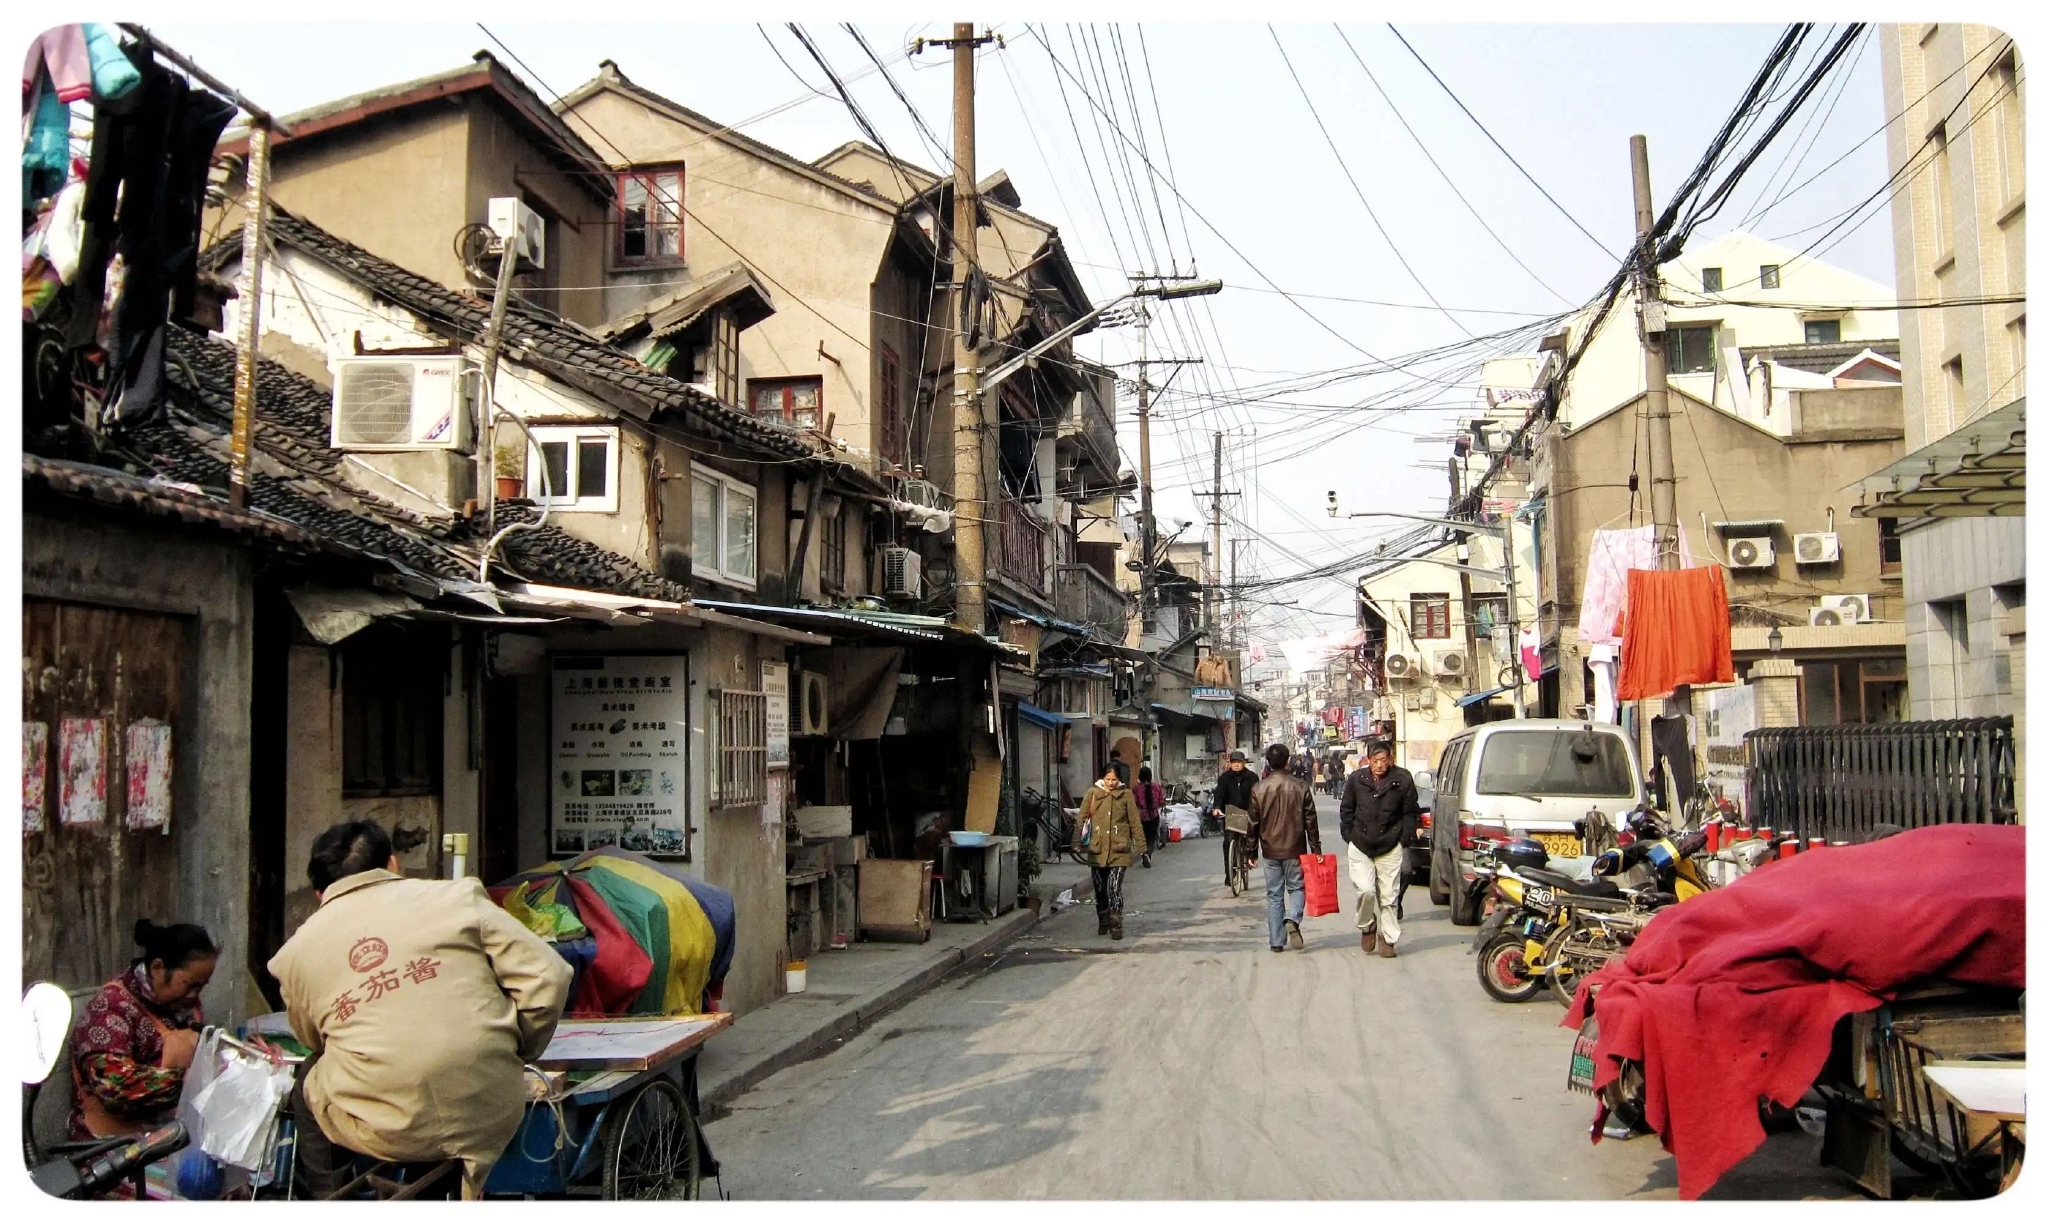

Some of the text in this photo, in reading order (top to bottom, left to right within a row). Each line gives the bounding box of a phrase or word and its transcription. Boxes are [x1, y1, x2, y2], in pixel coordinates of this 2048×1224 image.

[430, 369, 452, 377] GREE
[632, 722, 666, 731] 美术考级
[1526, 886, 1553, 906] 20
